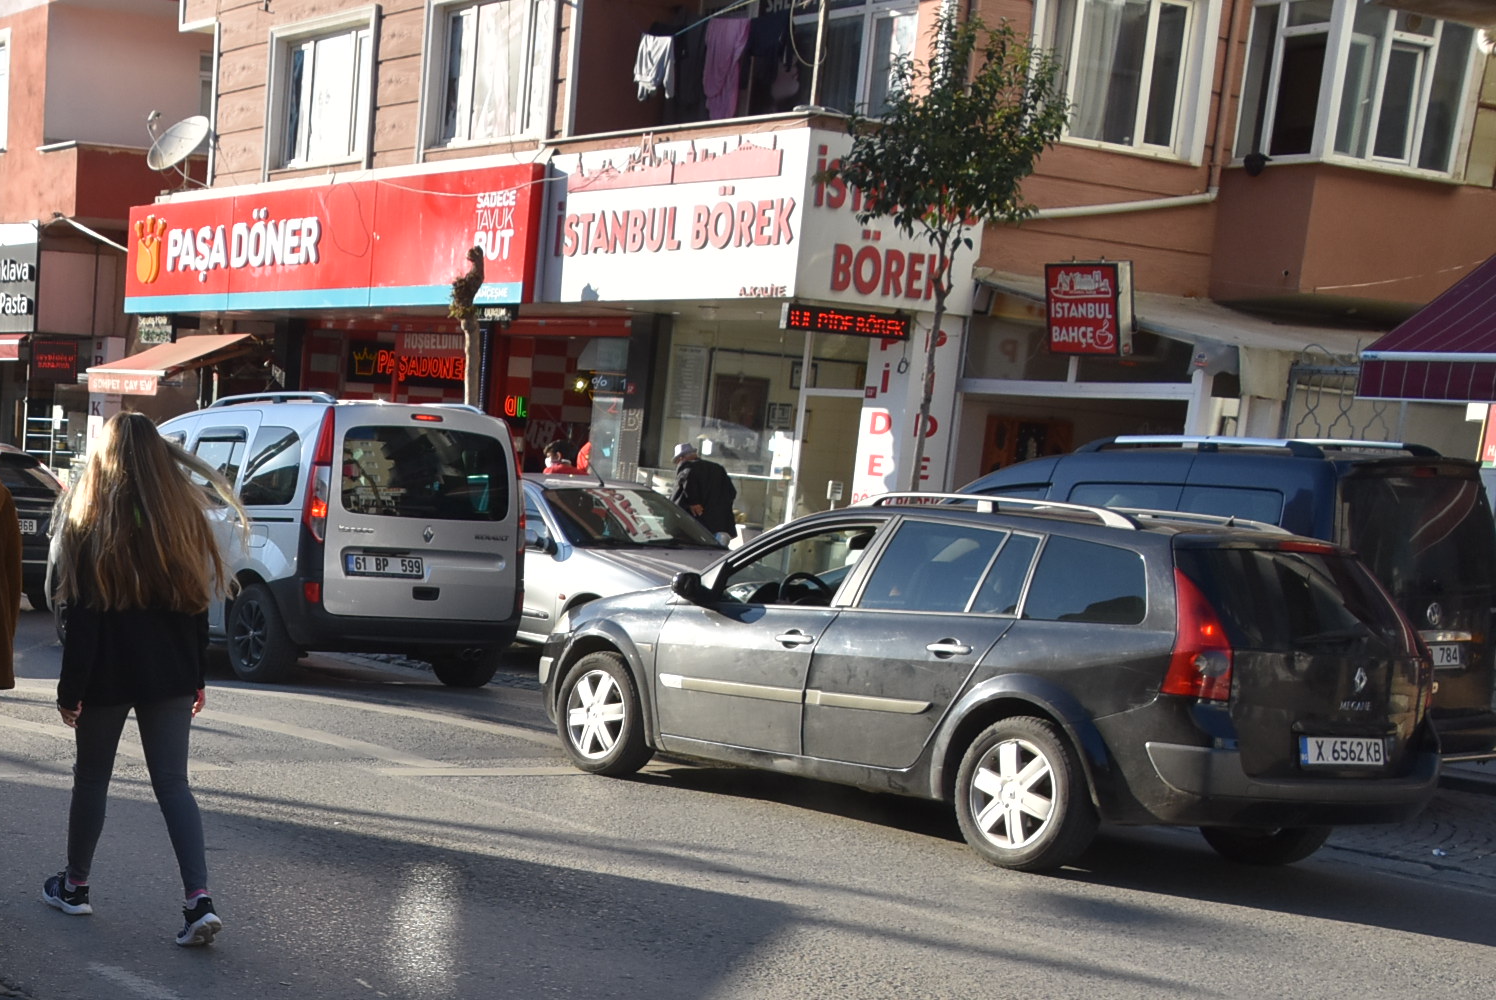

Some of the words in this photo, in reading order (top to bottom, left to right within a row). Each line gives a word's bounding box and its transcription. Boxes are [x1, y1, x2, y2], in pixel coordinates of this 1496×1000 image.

[476, 190, 517, 209] SADECE
[475, 208, 515, 230] TAVUK
[554, 201, 681, 258] İSTANBUL
[690, 186, 796, 250] BÖREK
[167, 223, 228, 283] PAŞA
[230, 207, 322, 269] DÖNER
[830, 229, 950, 300] BÖREK
[0, 292, 28, 314] Pasta
[1051, 298, 1113, 319] İSTANBUL
[1052, 326, 1094, 348] BAHÇE
[355, 556, 367, 571] 61
[375, 558, 389, 572] BP
[400, 559, 421, 574] 599
[1439, 647, 1458, 663] 784
